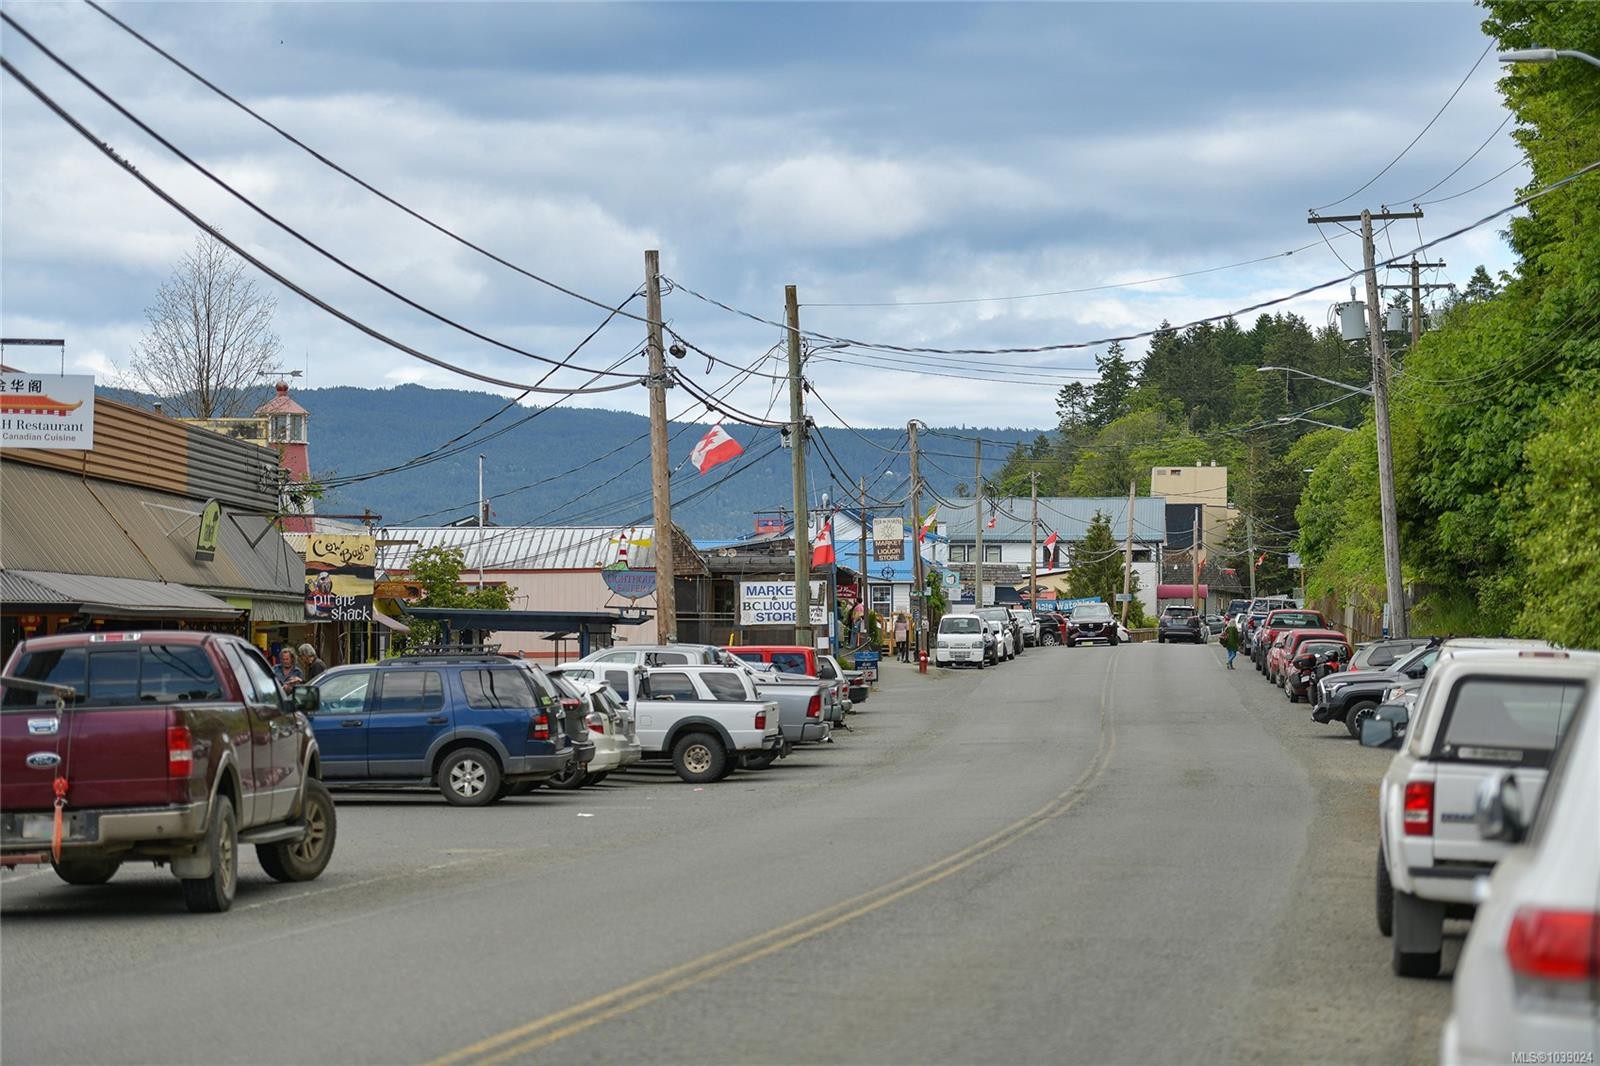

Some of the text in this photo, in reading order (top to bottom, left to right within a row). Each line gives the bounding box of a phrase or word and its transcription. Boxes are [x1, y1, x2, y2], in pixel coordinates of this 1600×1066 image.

[16, 419, 84, 432] Restaurant
[2, 432, 76, 442] Canadian Cuisine
[313, 539, 345, 557] Cow
[746, 585, 796, 596] MARKE
[313, 594, 356, 610] pirate
[763, 601, 796, 611] LIQUO
[1036, 601, 1053, 611] hale
[331, 605, 372, 621] shack
